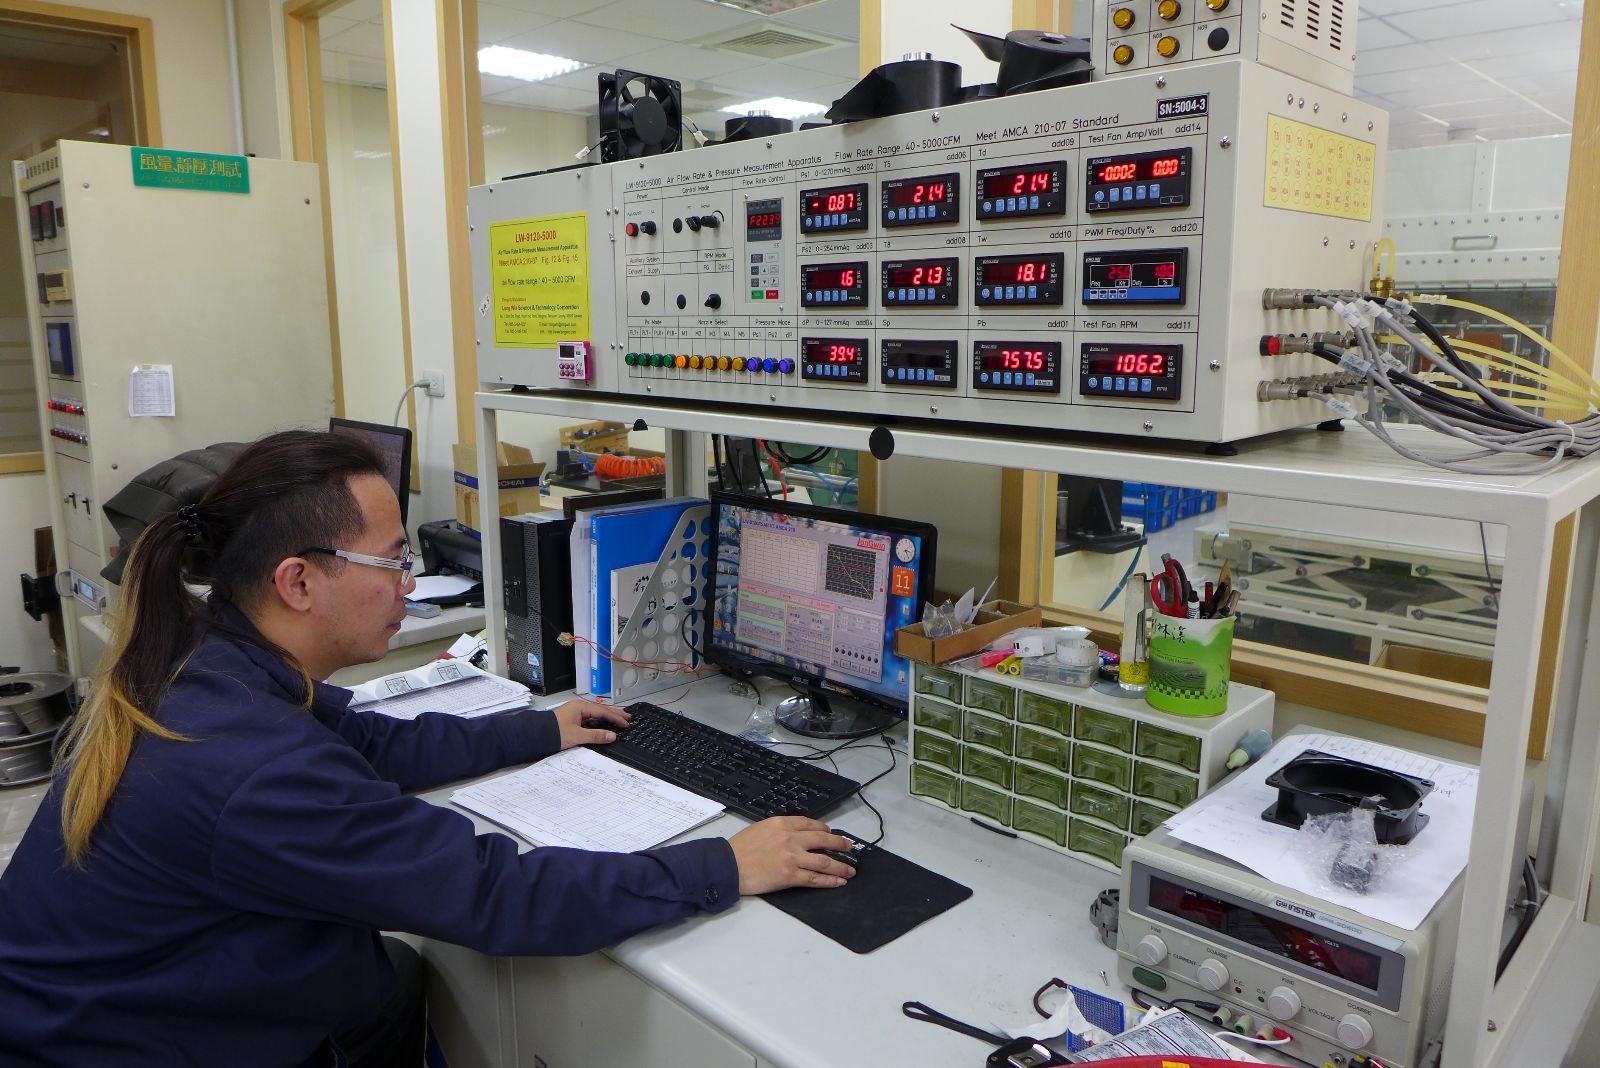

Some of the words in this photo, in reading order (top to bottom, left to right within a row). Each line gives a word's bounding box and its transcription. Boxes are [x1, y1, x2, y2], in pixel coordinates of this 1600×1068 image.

[1159, 98, 1206, 116] SN:5004-3
[1088, 134, 1104, 144] Test
[1106, 132, 1122, 142] Fan
[1126, 126, 1164, 141] Amp/Volt
[1175, 123, 1202, 134] add14
[667, 175, 675, 184] Air
[676, 173, 690, 182] Flow
[693, 171, 706, 180] Rate
[708, 170, 713, 178] &
[715, 166, 740, 177] Pressure
[744, 160, 784, 172] Measurement
[788, 156, 822, 168] Apparatus
[835, 152, 852, 160] Flow
[856, 148, 874, 158] Rate
[976, 131, 997, 142] Meet
[1002, 125, 1028, 138] AMCA
[1034, 121, 1066, 134] 210-07
[1072, 114, 1119, 130] Standard
[978, 148, 987, 156] Td
[1051, 138, 1075, 148] add09
[768, 174, 786, 183] Control
[698, 184, 710, 192] Mode
[978, 236, 988, 244] Tw
[1050, 230, 1072, 240] add10
[1084, 229, 1104, 238] PWM
[1170, 222, 1198, 233] add20
[551, 255, 558, 263] 12
[572, 254, 578, 262] 15
[912, 266, 943, 286] 21.3
[1017, 262, 1046, 282] 18.1
[1048, 320, 1068, 328] add01
[1082, 320, 1098, 329] Test
[1102, 321, 1116, 329] Fan
[1120, 321, 1138, 329] RPM
[1166, 321, 1191, 330] add11
[896, 574, 910, 590] 11
[1324, 938, 1340, 948] VOLTS
[1172, 953, 1197, 966] CURRENT
[1206, 947, 1228, 960] COARSE
[1308, 1007, 1336, 1022] VOLTAGE
[1347, 1002, 1372, 1016] COARSE
